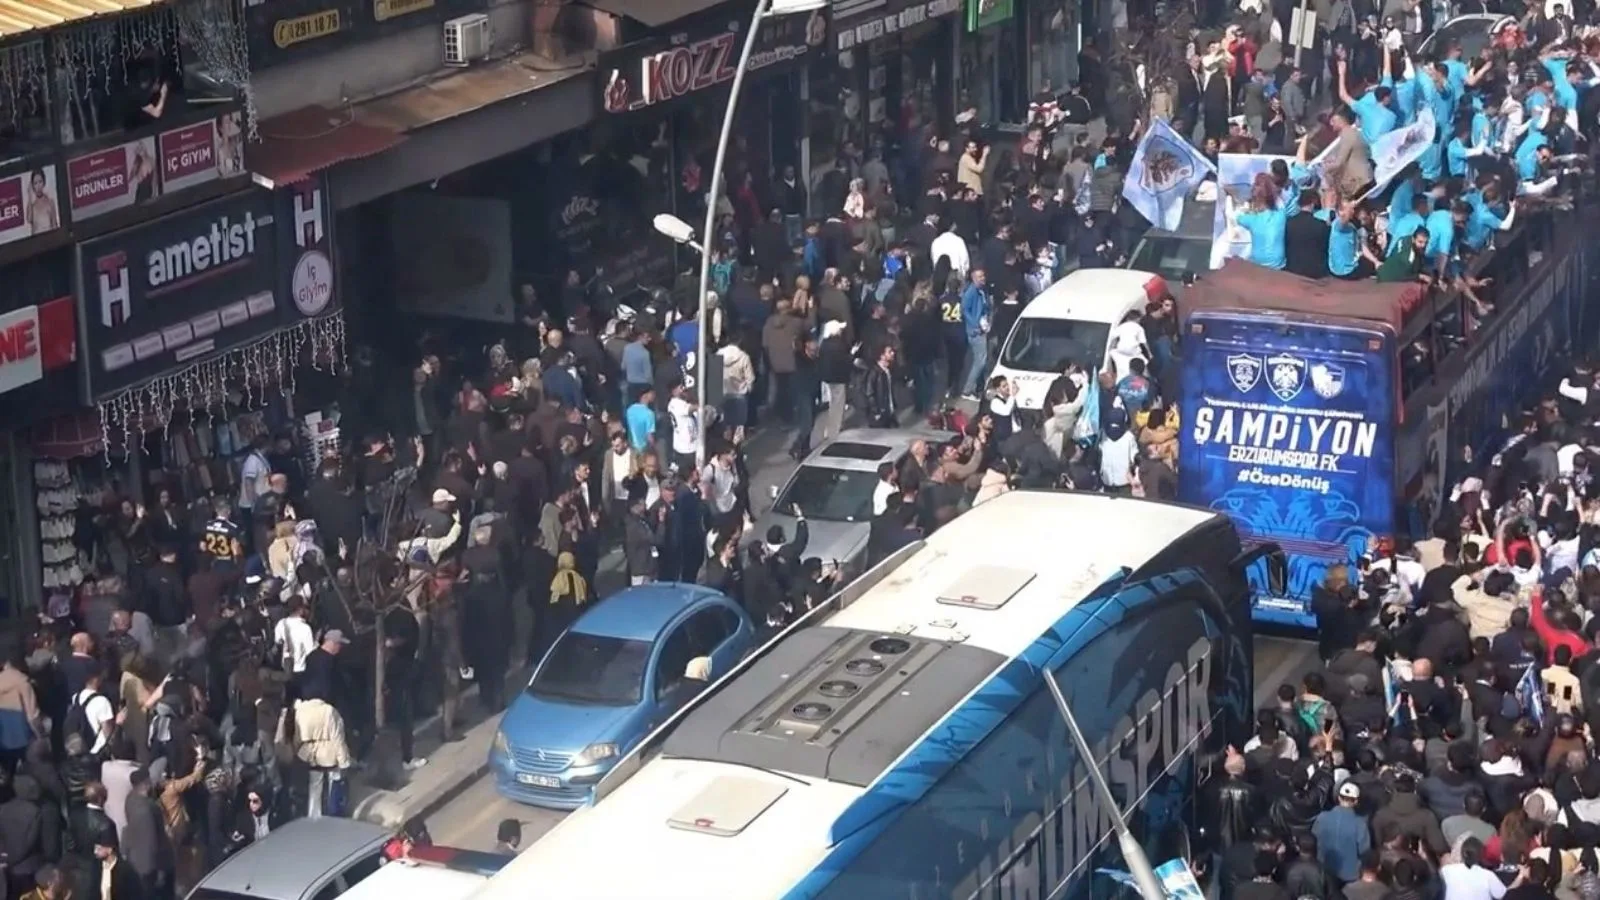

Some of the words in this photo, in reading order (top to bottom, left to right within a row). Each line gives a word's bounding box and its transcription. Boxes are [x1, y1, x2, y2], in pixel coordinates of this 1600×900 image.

[642, 32, 737, 105] KOZZ
[148, 211, 255, 286] ametist
[941, 302, 962, 322] 24
[1237, 467, 1330, 495] #ÖzeDönüş
[206, 533, 231, 556] 23
